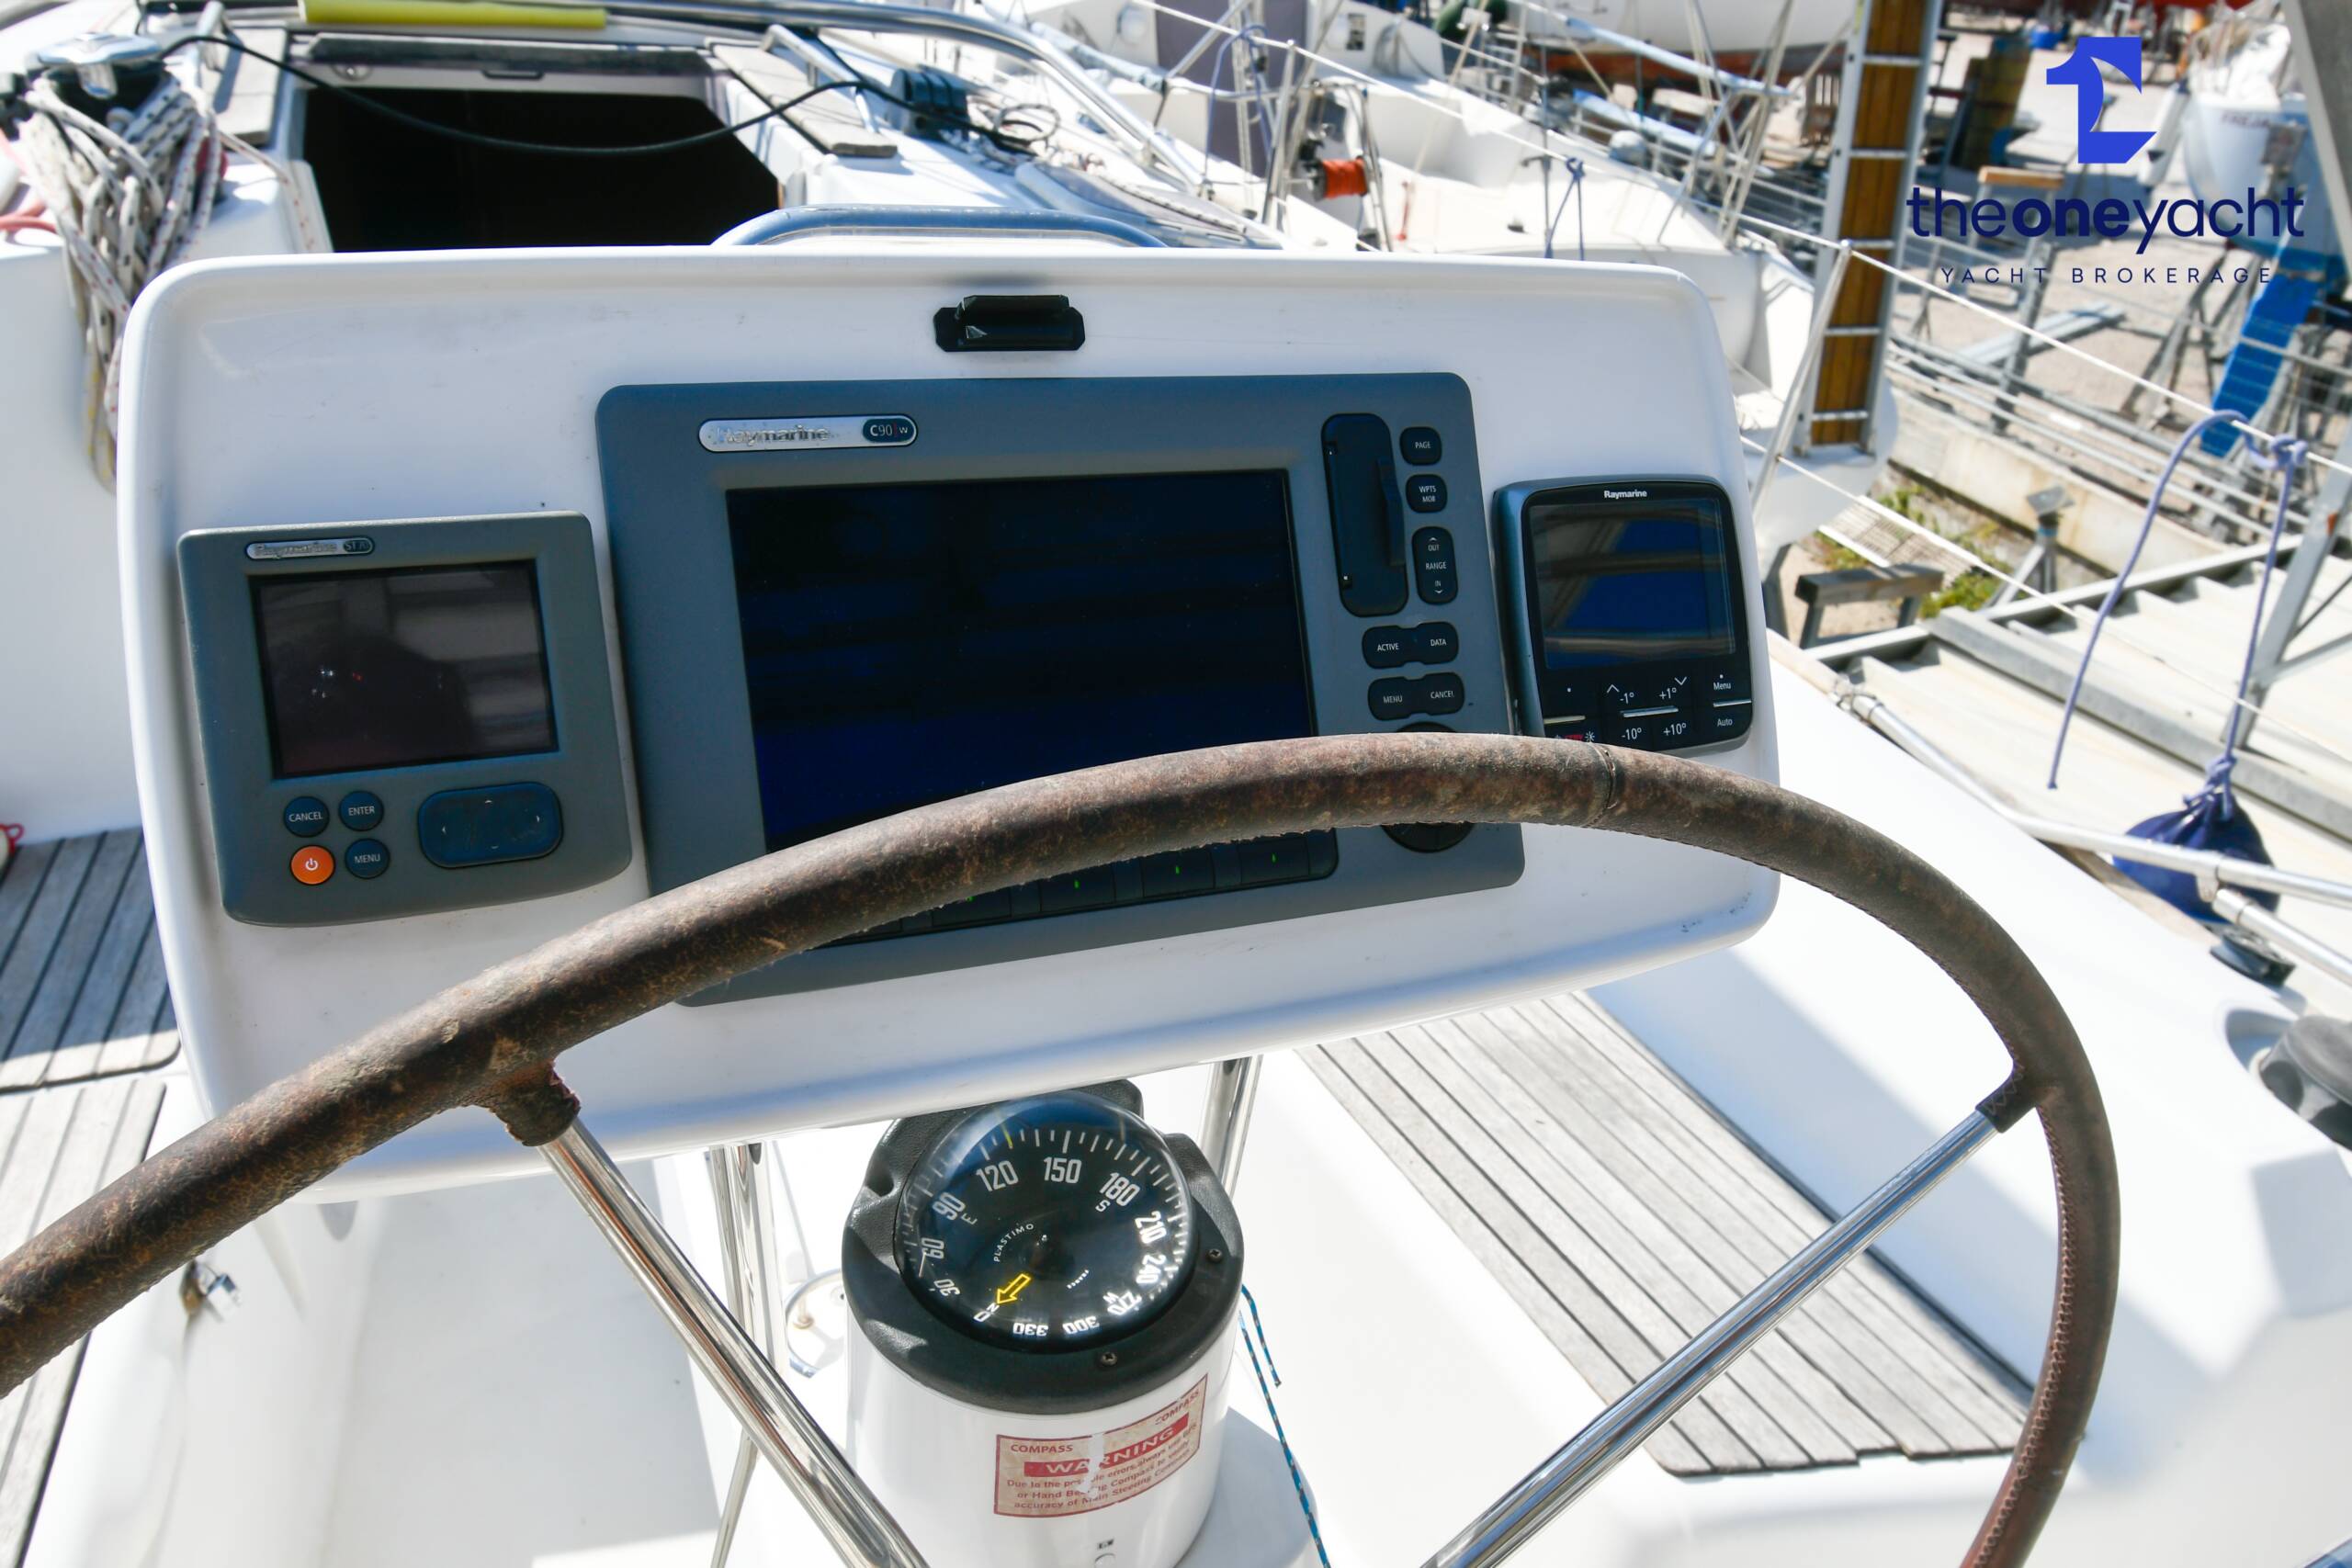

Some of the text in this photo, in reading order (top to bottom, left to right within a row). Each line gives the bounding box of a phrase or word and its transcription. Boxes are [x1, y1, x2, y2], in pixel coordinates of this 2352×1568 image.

[1415, 441, 1431, 450] PAGE
[1419, 485, 1437, 494] WPTS
[1604, 490, 1647, 499] Raymarine
[1422, 495, 1436, 503] MOB
[1426, 560, 1447, 571] RANGE
[1434, 580, 1442, 588] IN
[1377, 638, 1447, 652] ACTIVE DATA
[1713, 682, 1731, 691] Menu
[1383, 690, 1455, 705] MENU CANCEL
[1717, 717, 1734, 728] Auto
[288, 805, 375, 823] CANCEL ENTER
[354, 852, 380, 863] MENU
[976, 1159, 1019, 1192] 120
[1043, 1156, 1082, 1185] 150
[1099, 1172, 1140, 1207] 180
[932, 1192, 966, 1221] 90
[1095, 1200, 1111, 1212] S
[961, 1213, 978, 1225] E
[1135, 1211, 1167, 1244] 210
[921, 1237, 944, 1259] 60
[993, 1223, 1035, 1263] PLASTIMO
[1012, 1322, 1049, 1337] 330
[1062, 1314, 1100, 1335] 300
[1155, 1388, 1200, 1425] COMPASS
[1011, 1444, 1073, 1453] COMPASS
[1007, 1480, 1027, 1488] Due
[1044, 1480, 1060, 1488] the
[1032, 1491, 1062, 1499] Hand
[1067, 1498, 1078, 1506] of
